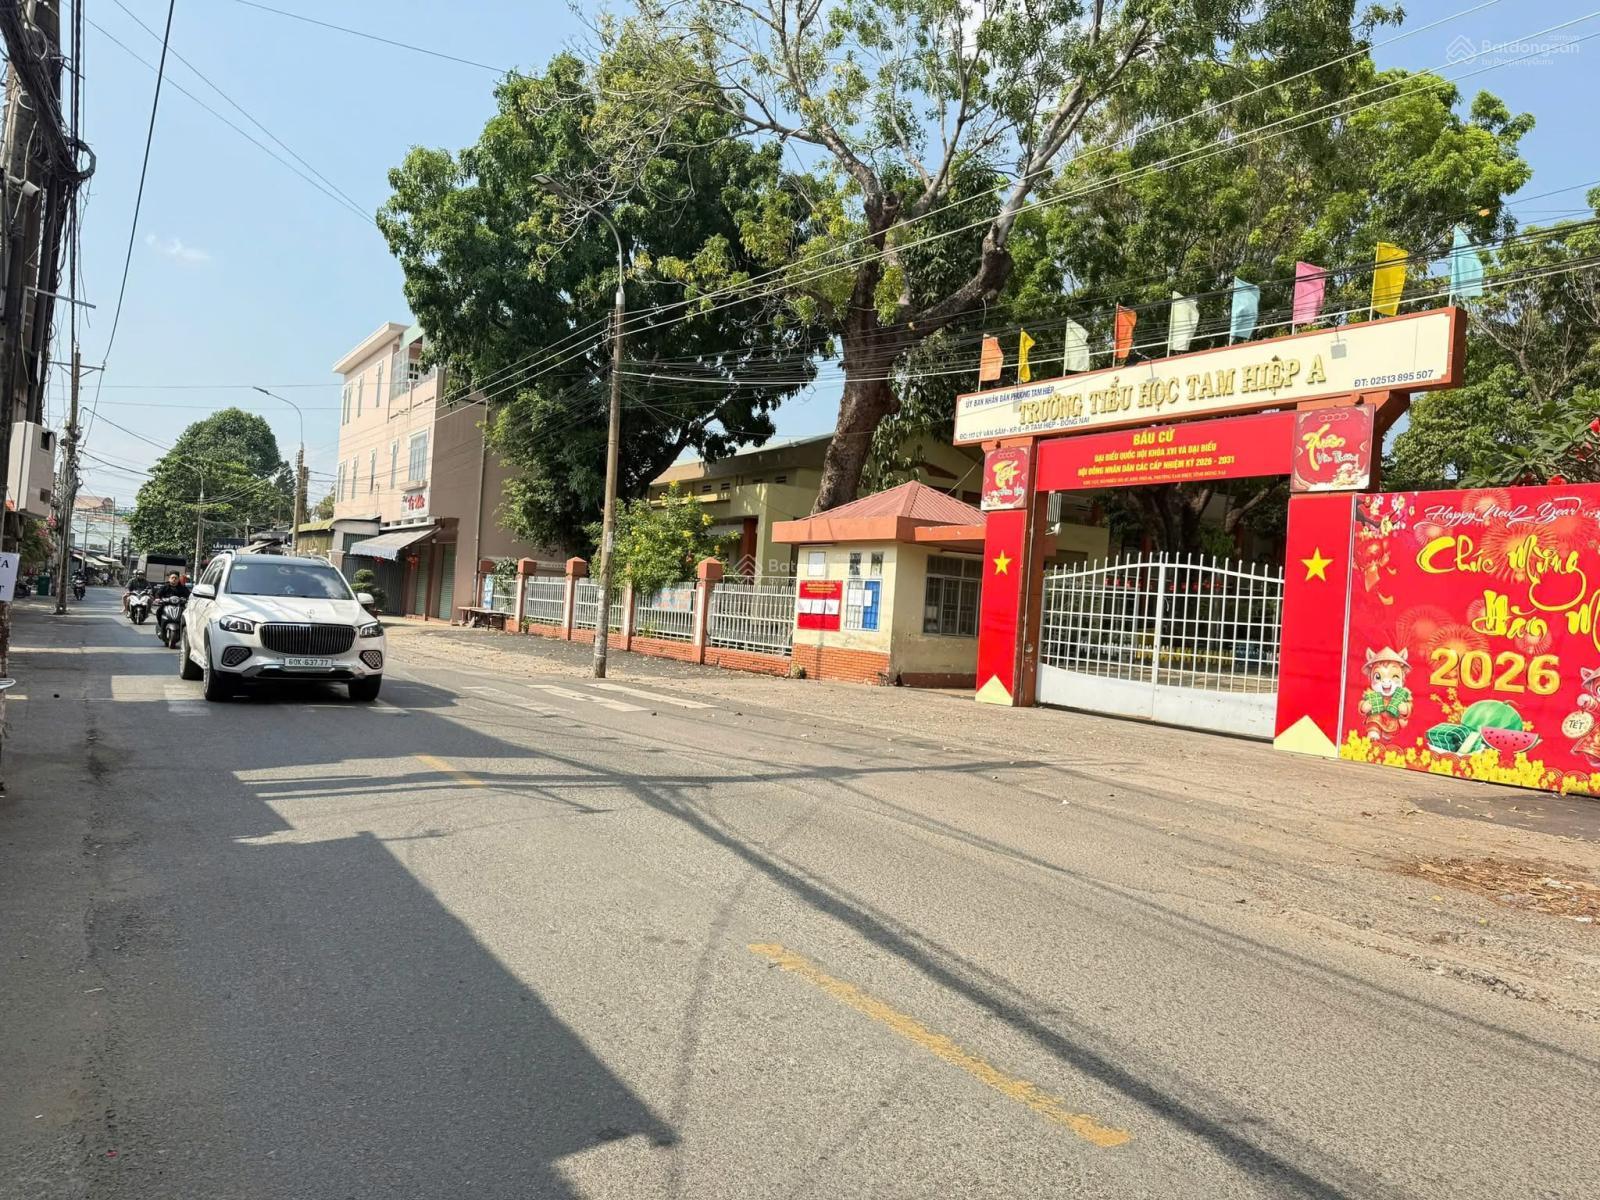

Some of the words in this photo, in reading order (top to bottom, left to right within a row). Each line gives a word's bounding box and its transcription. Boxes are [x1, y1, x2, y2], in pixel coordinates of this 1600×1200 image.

[1354, 379, 1369, 388] ĐT:
[1370, 375, 1396, 386] 02513
[1397, 372, 1415, 382] 895
[1416, 369, 1434, 380] 507
[974, 399, 984, 407] BAN
[1032, 387, 1042, 397] TAM
[1018, 390, 1084, 426] TRƯỜNG
[1089, 376, 1134, 415] TIỂU
[1137, 377, 1180, 412] HỌC
[1187, 368, 1237, 401] TAM
[1241, 355, 1301, 396] HIỆP
[1306, 354, 1327, 385] A
[1031, 423, 1042, 431] TAM
[1079, 416, 1090, 424] NAI
[1133, 429, 1155, 446] BẦU
[1158, 427, 1175, 443] CỬ
[1166, 446, 1177, 455] XVI
[1218, 455, 1235, 465] 2031
[1413, 504, 1484, 529] Happy
[1480, 504, 1534, 521] New
[1416, 534, 1496, 574] Chúc
[1508, 534, 1587, 611] Mừng
[1429, 647, 1561, 696] 2026
